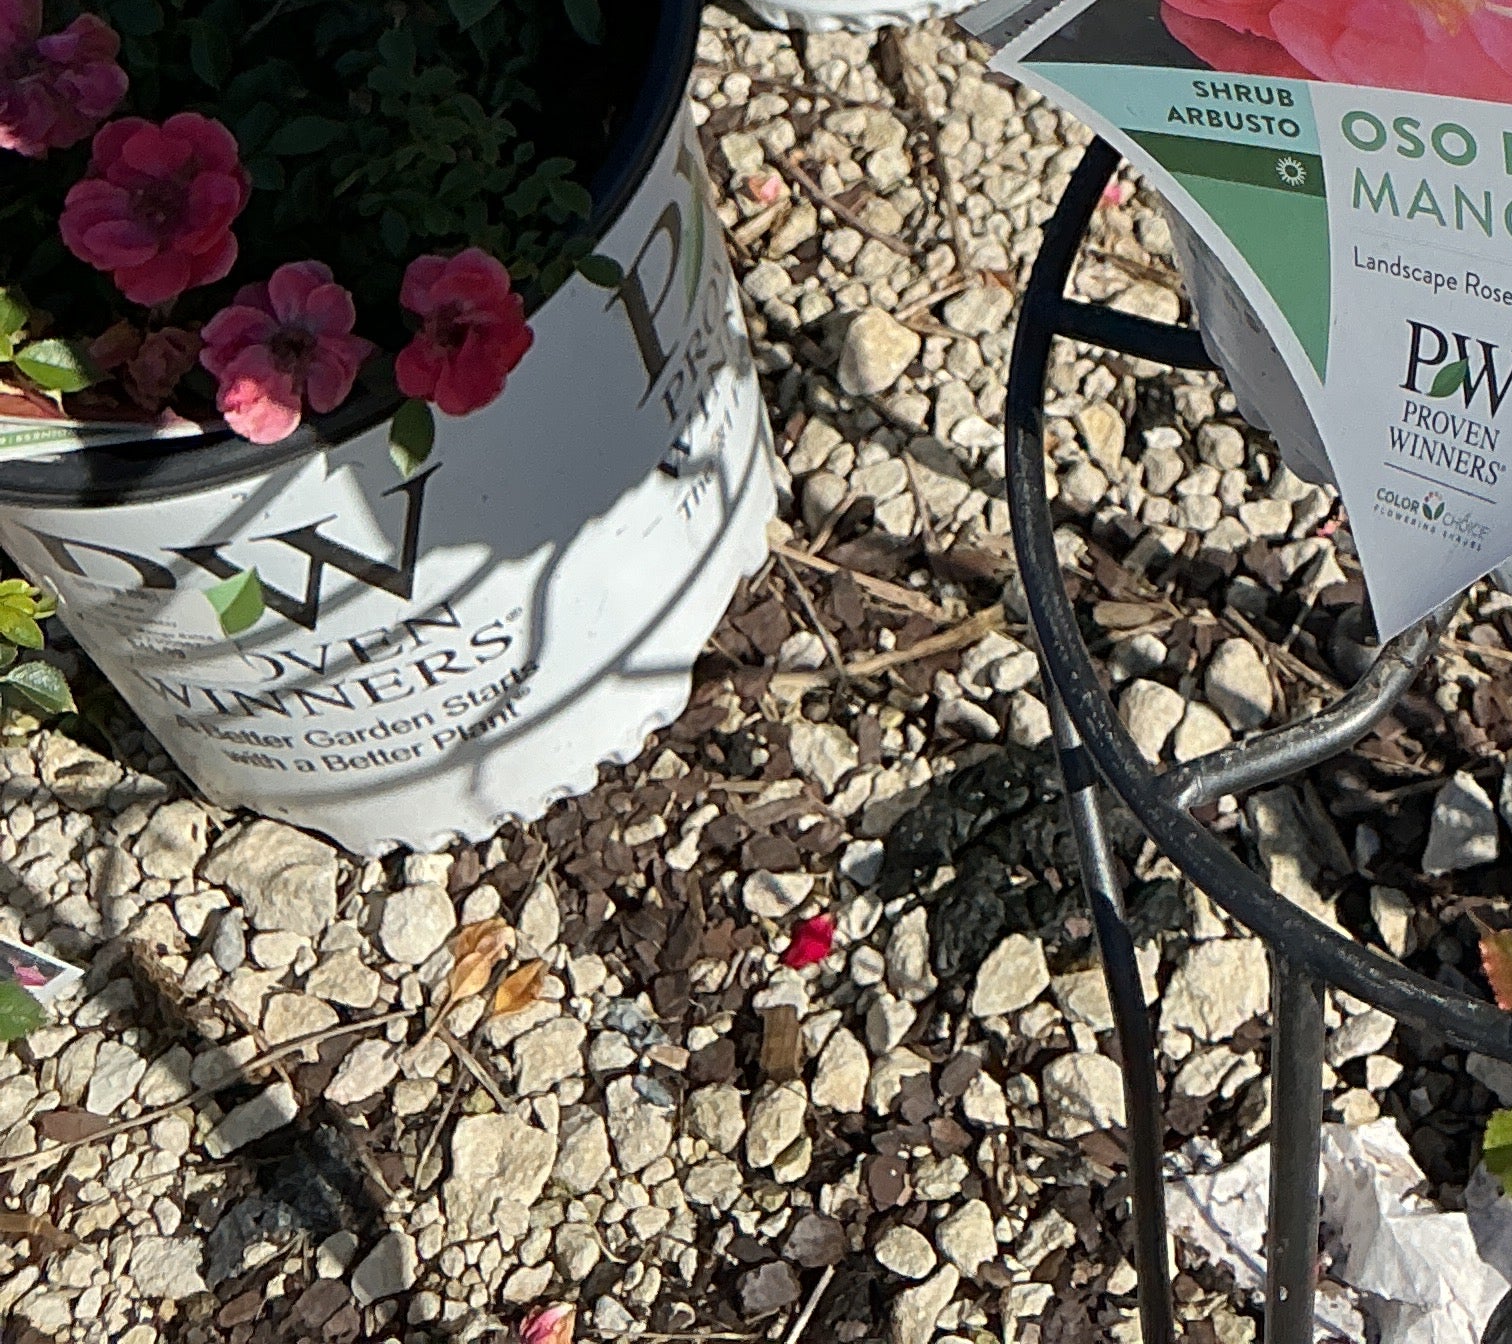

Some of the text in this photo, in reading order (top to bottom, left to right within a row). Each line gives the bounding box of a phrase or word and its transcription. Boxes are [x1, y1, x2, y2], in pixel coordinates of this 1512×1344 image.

[1192, 80, 1295, 107] SHRUB
[1167, 105, 1301, 138] ARBUSTO
[1341, 110, 1477, 166] OSO
[1353, 246, 1457, 295] Landscape
[1401, 399, 1501, 452] PROVEN
[1376, 487, 1420, 515] COLOR
[200, 722, 294, 750] Better
[304, 712, 434, 749] Garden
[442, 659, 540, 718] Starts
[223, 748, 288, 772] with
[294, 757, 316, 773] a
[321, 741, 424, 773] Better
